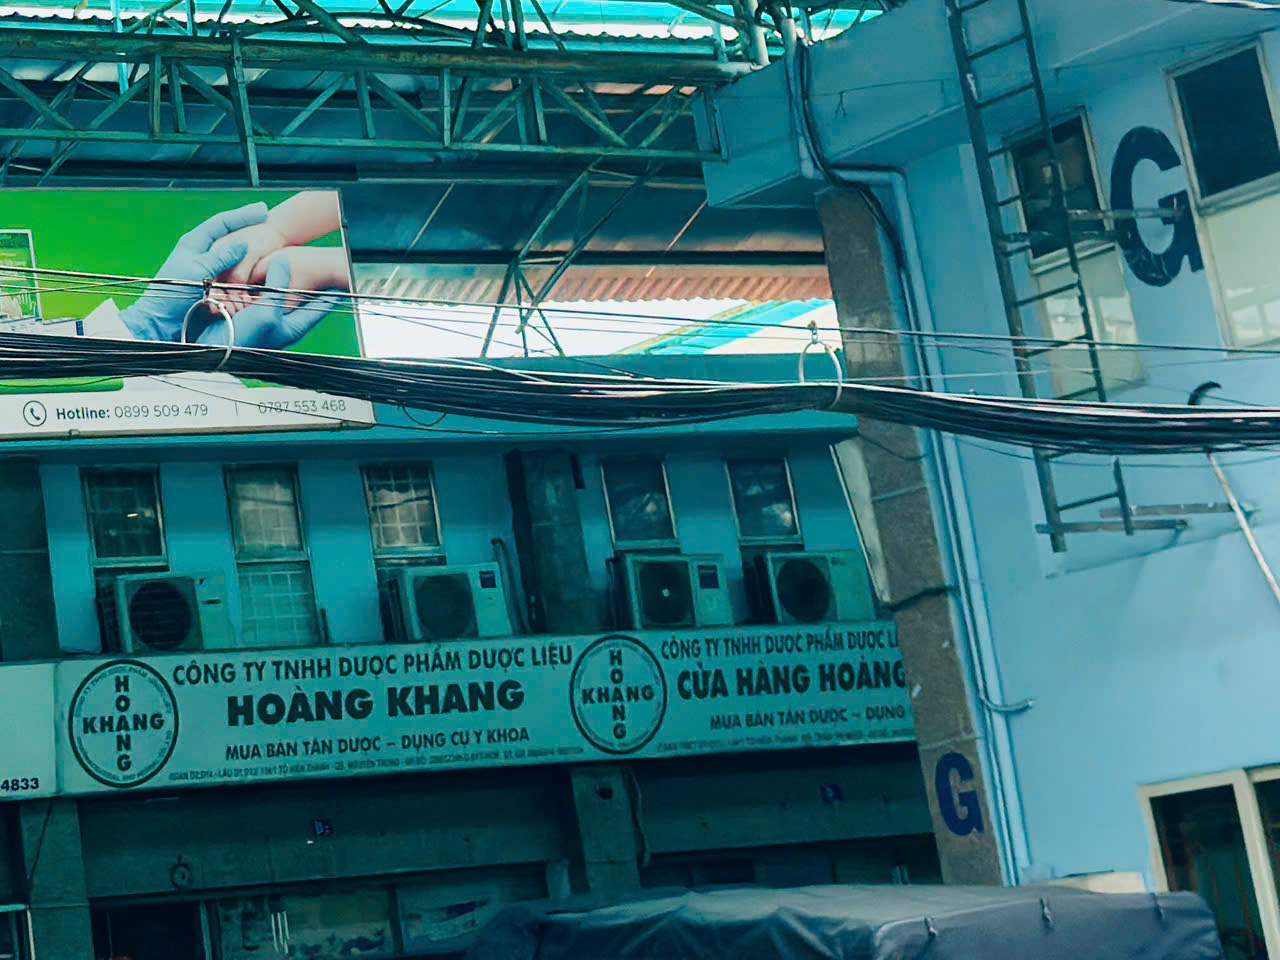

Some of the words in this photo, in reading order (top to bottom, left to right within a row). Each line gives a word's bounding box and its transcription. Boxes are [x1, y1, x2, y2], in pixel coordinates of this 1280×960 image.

[1109, 126, 1204, 287] G
[56, 407, 110, 420] Hotline:
[114, 406, 149, 418] 0899
[153, 405, 180, 417] 509
[184, 404, 208, 416] 479
[173, 659, 236, 685] CÔNG
[243, 661, 268, 681] TY
[271, 657, 332, 680] TNHH
[677, 661, 729, 700] CỬA
[736, 660, 811, 697] HÀNG
[226, 685, 374, 727] HOÀNG
[387, 680, 525, 717] KHANG
[83, 713, 165, 734] KHANG
[225, 743, 262, 761] MUA
[474, 729, 485, 743] Y
[487, 727, 530, 744] KHOA
[935, 752, 985, 837] G
